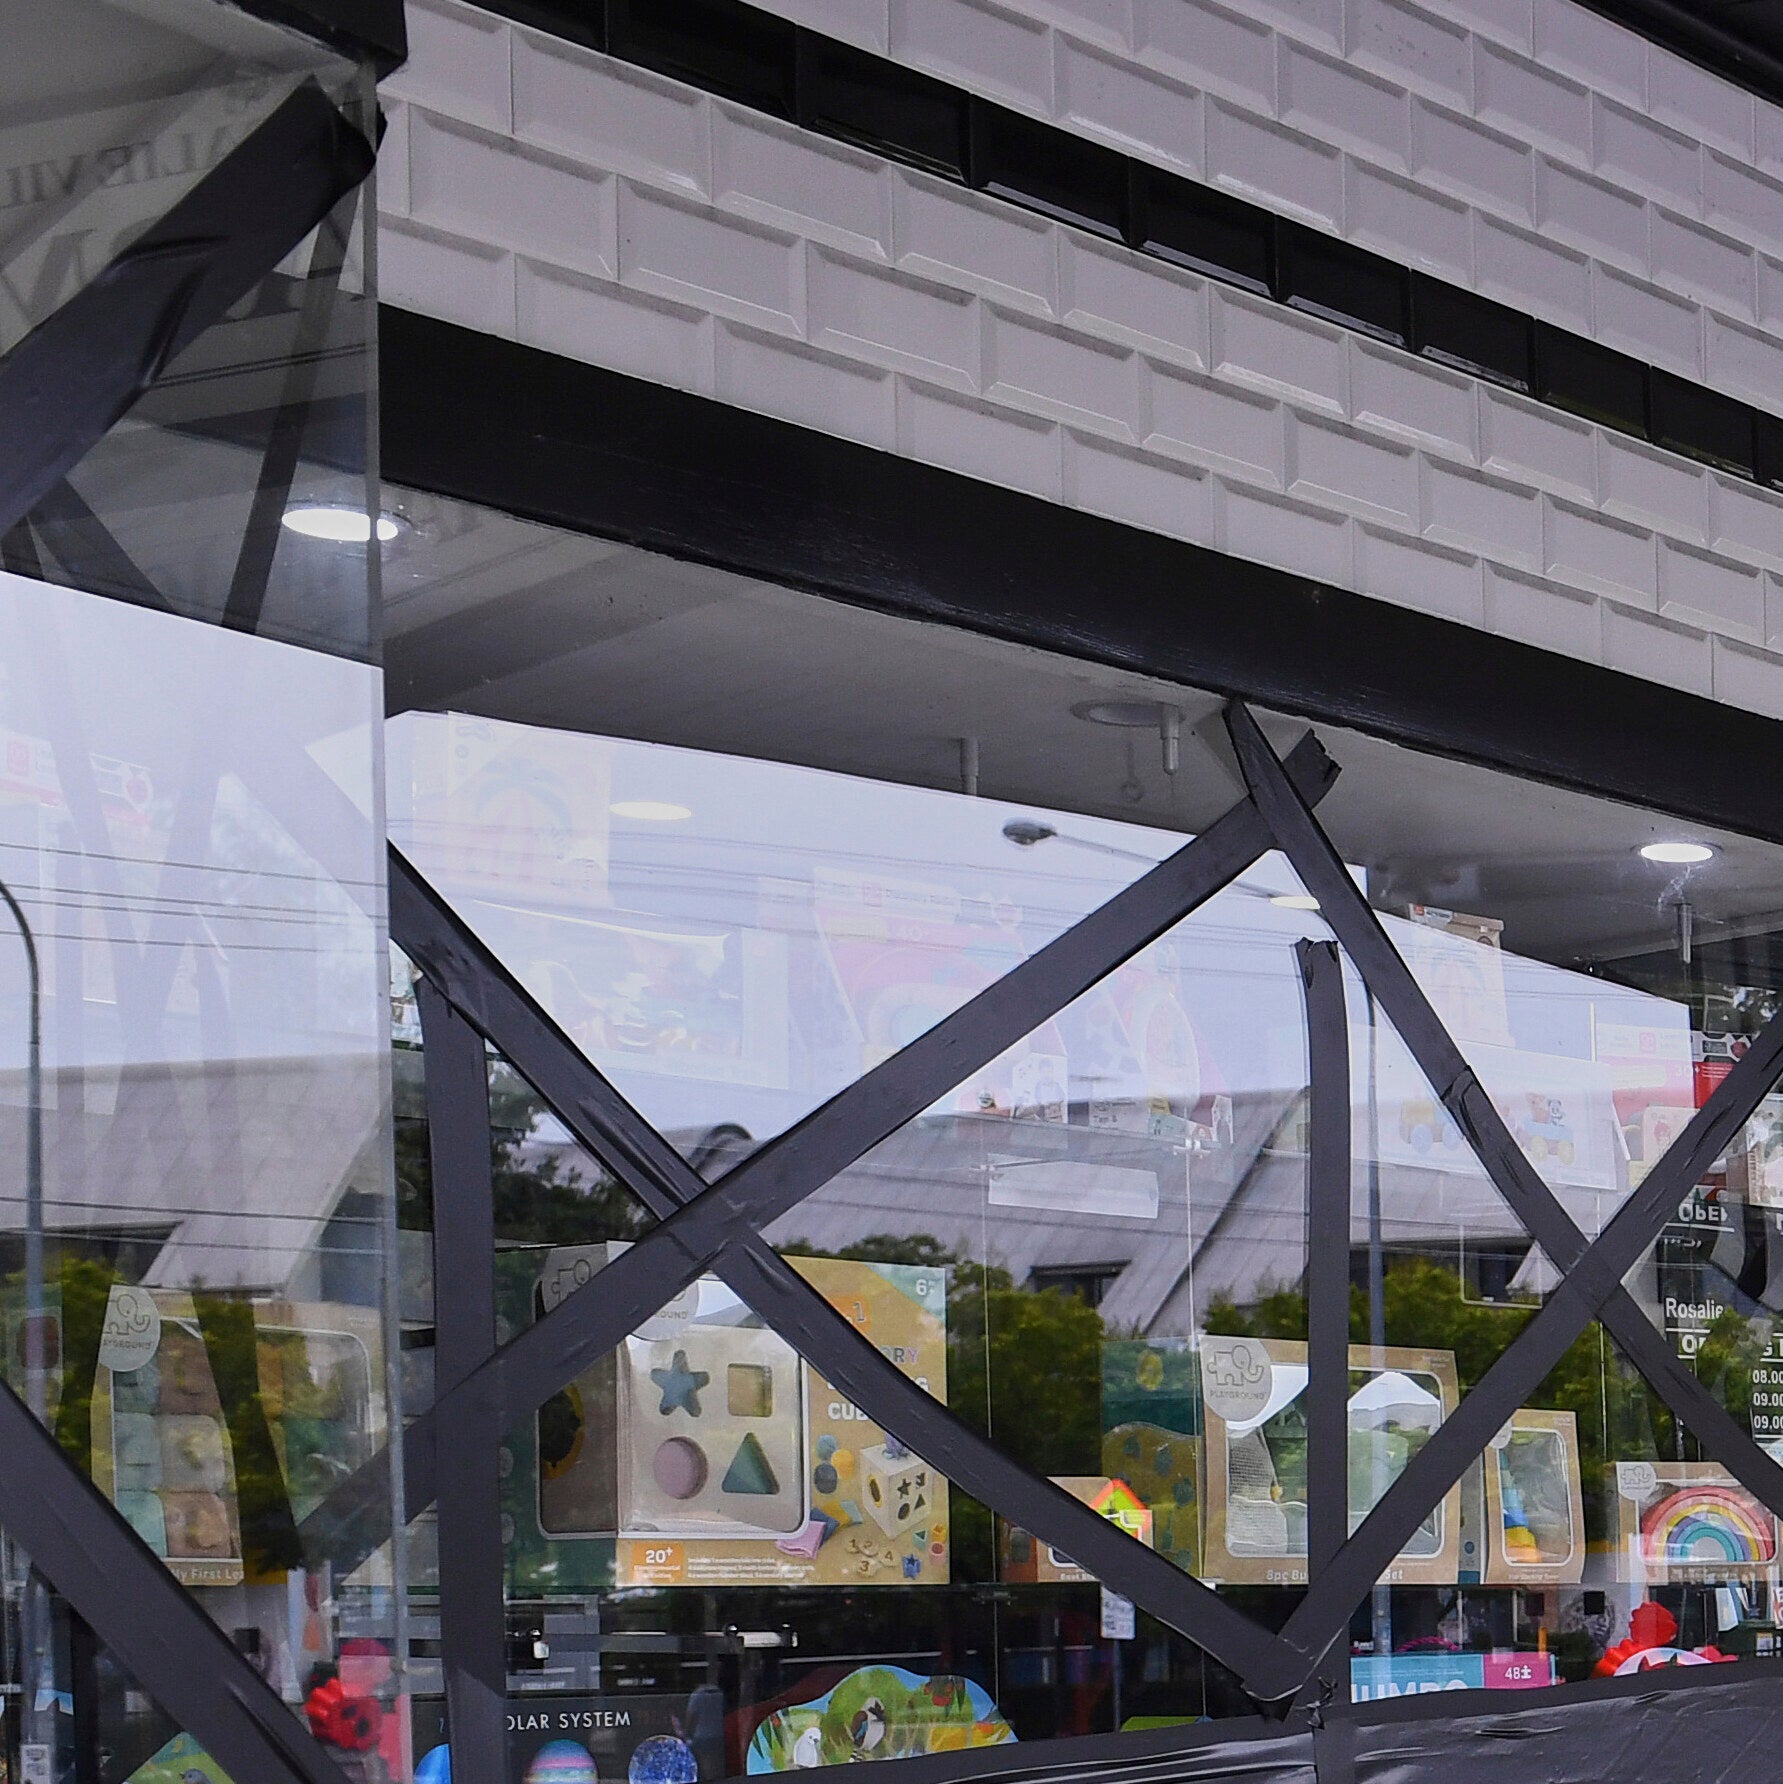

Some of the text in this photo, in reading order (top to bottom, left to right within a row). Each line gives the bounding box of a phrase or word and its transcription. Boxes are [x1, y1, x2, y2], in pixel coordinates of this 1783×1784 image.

[1666, 1298, 1723, 1320] Rosalie
[190, 1567, 221, 1580] First
[1505, 1667, 1521, 1680] 48
[507, 1711, 631, 1731] OLAR SYSTEM
